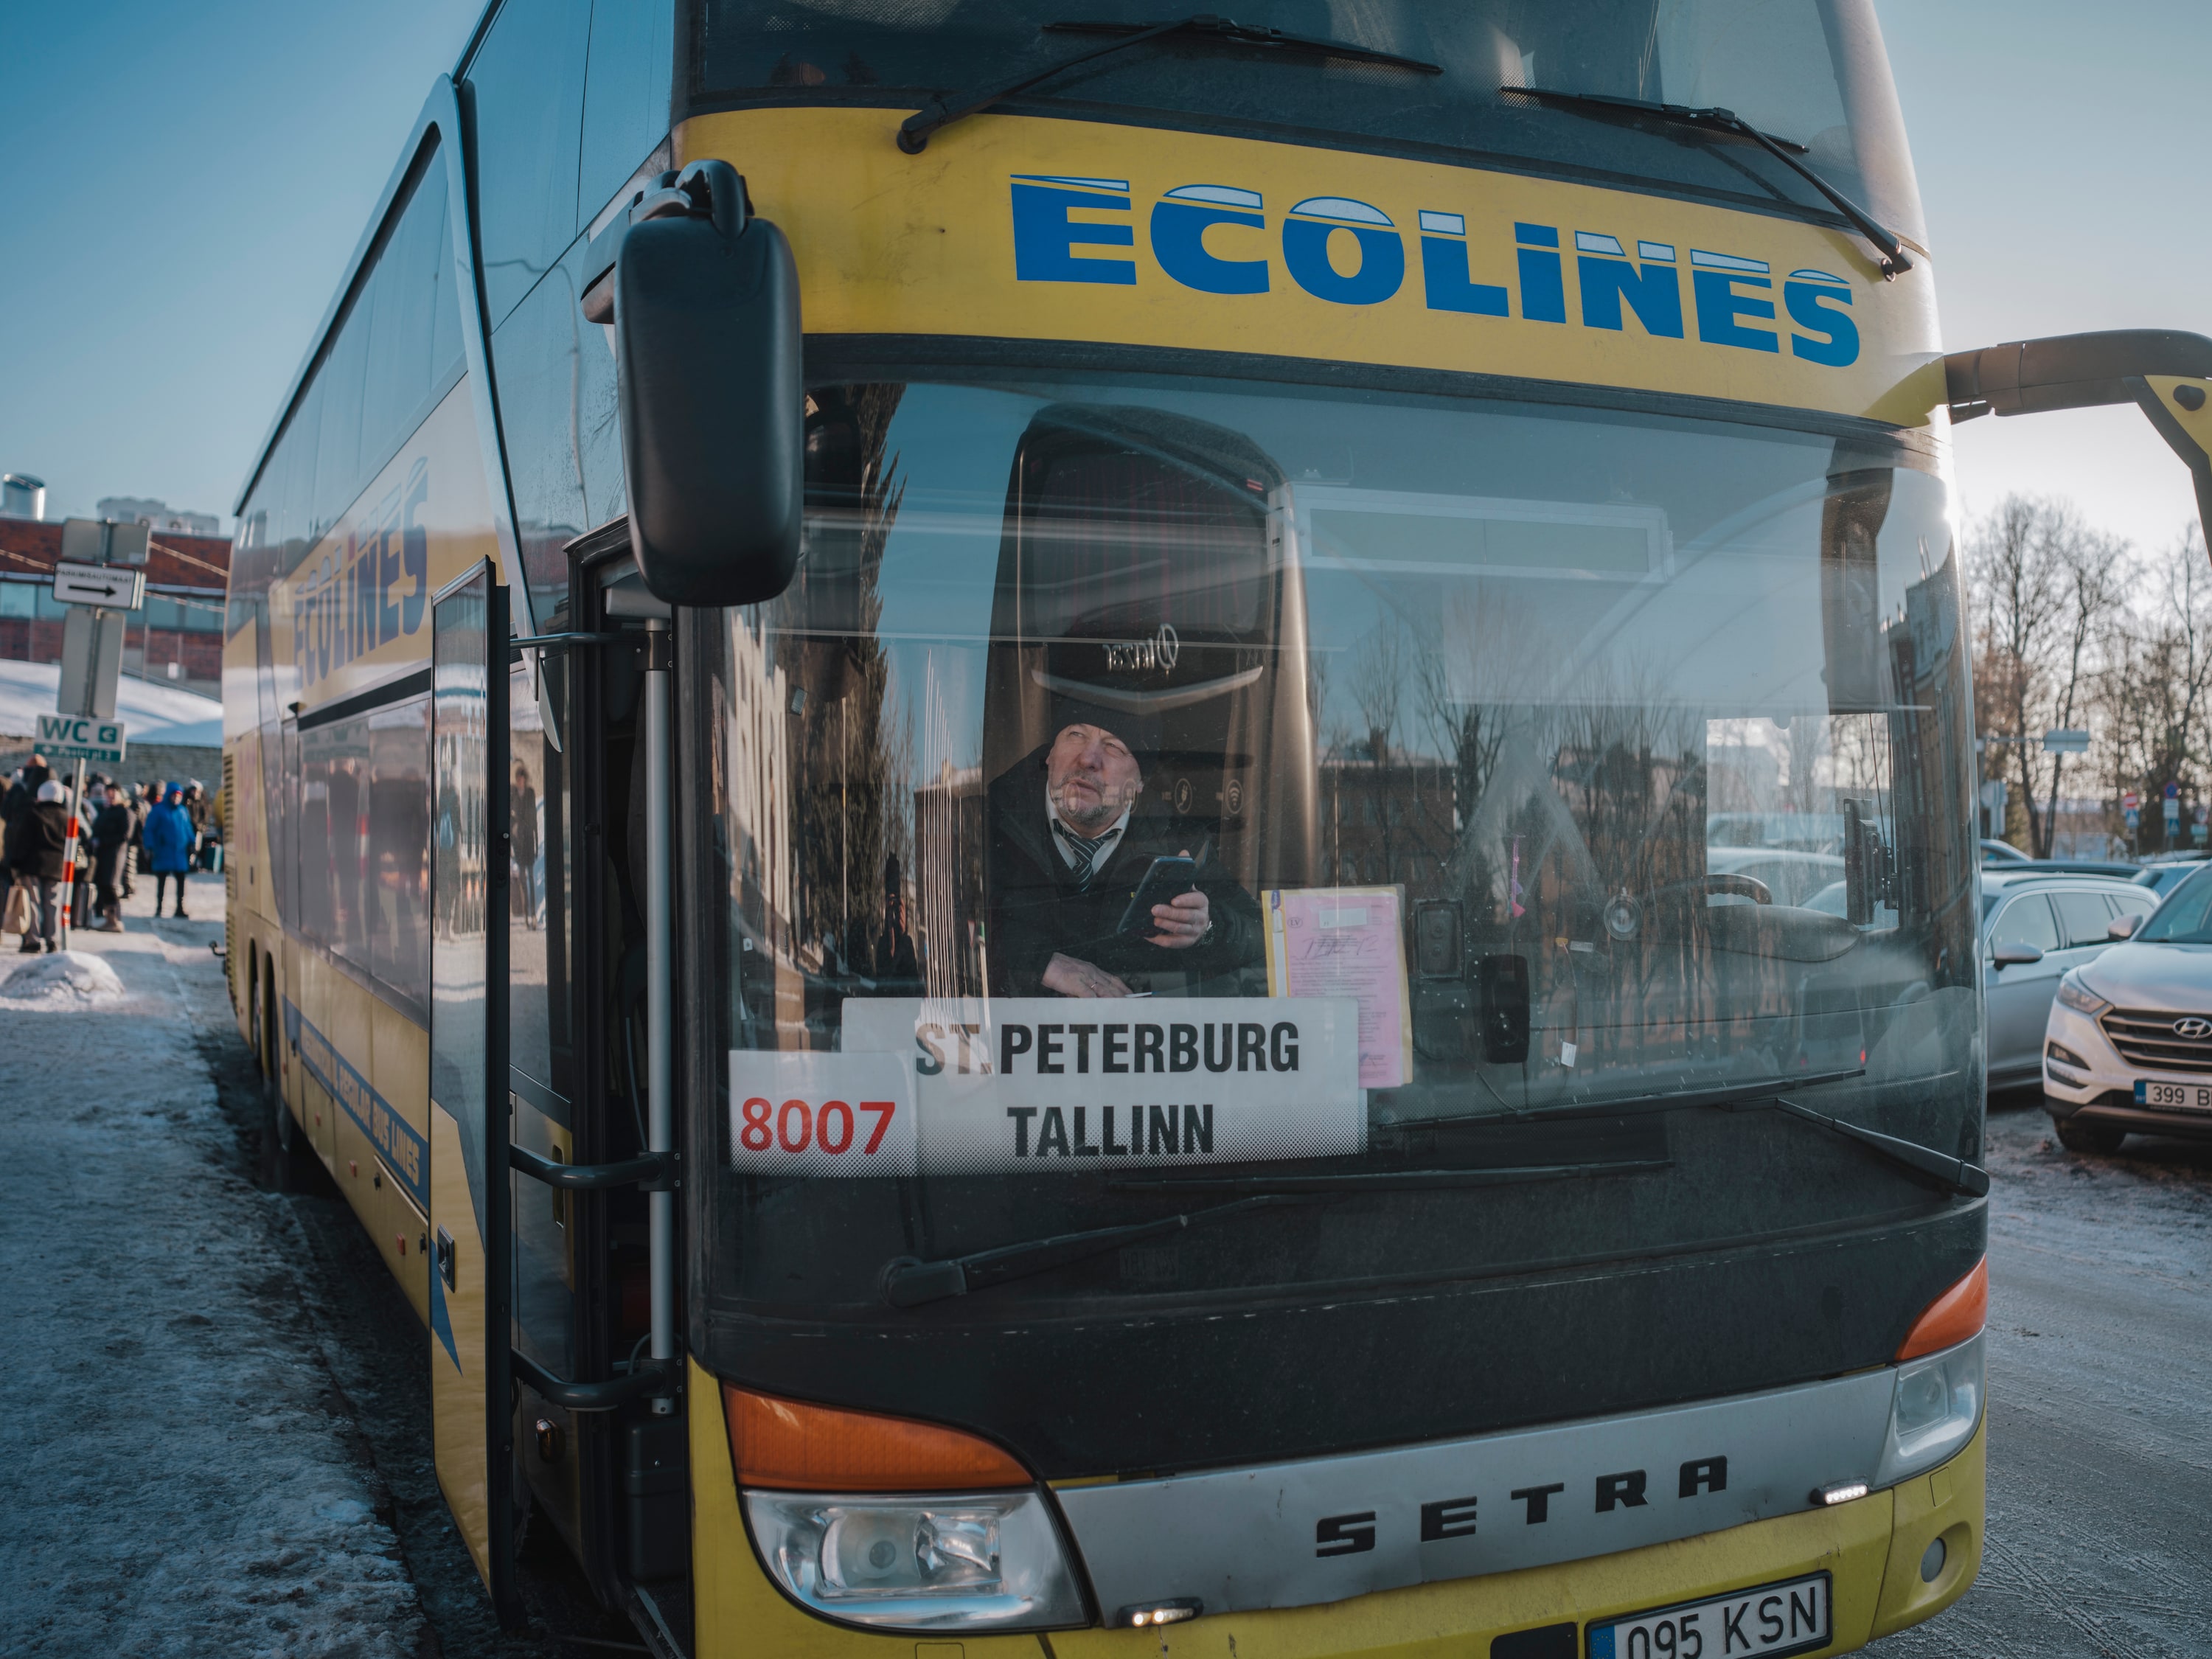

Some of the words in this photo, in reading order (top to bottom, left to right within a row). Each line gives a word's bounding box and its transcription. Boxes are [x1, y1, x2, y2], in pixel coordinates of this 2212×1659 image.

[1009, 173, 1861, 368] ECOLINES
[293, 456, 428, 690] ECOLINES
[41, 717, 90, 742] WC
[1001, 1021, 1299, 1074] PETERBURG
[740, 1096, 896, 1155] 8007
[2152, 1085, 2185, 1104] 399
[2197, 1089, 2212, 1106] B
[392, 1120, 420, 1186] LINES
[1007, 1104, 1214, 1158] TALLINN
[1316, 1454, 1728, 1559] SETRA
[1627, 1613, 1703, 1659] 095
[1722, 1586, 1815, 1655] KSN
